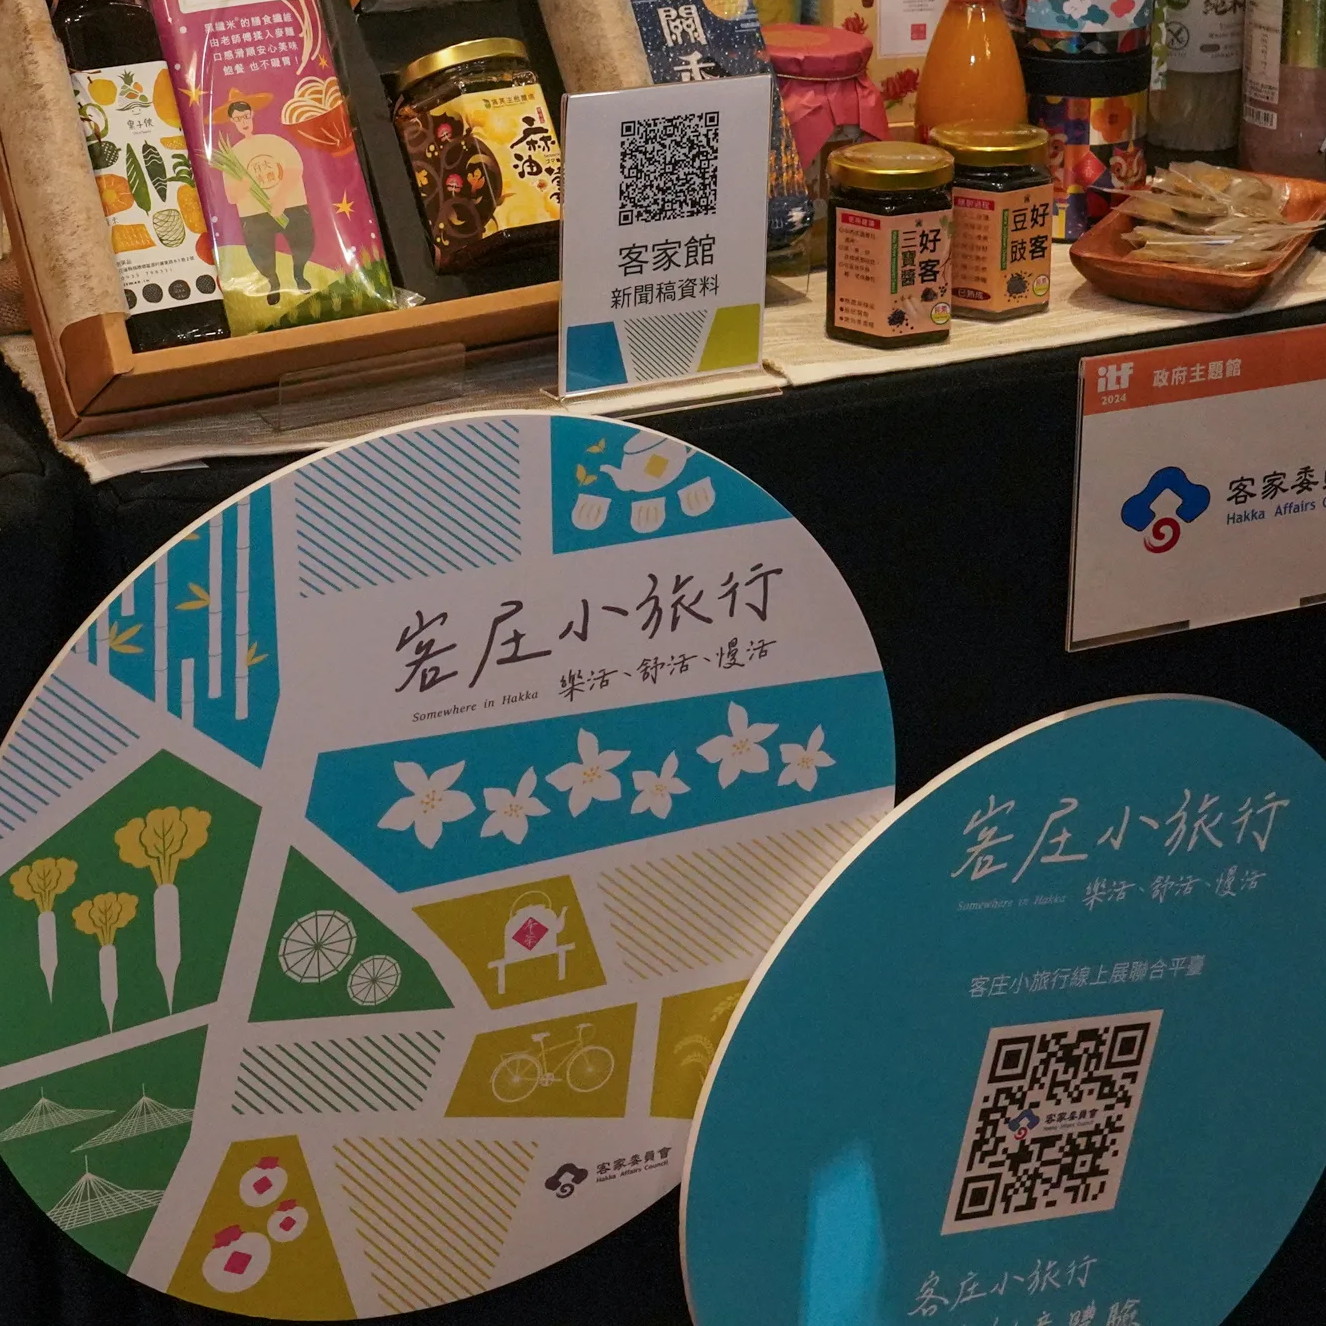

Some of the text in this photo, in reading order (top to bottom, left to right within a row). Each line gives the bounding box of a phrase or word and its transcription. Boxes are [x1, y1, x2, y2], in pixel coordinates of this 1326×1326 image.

[617, 233, 717, 277] 客家館
[610, 275, 720, 310] 新聞稿資料
[1097, 361, 1134, 393] itf
[1152, 357, 1243, 388] 政府主題館
[1101, 393, 1128, 405] 2024
[1226, 507, 1266, 526] Hakka
[1274, 499, 1317, 518] Affairs
[411, 688, 540, 725] Somewhere in Hakka
[956, 896, 1014, 912] Somewhere
[1033, 893, 1066, 906] Hakka
[968, 953, 1206, 1000] 客庄小旅行線上展聯合平臺
[596, 1146, 672, 1175] 客家委員會
[596, 1159, 669, 1183] Hakka Affairs Council
[907, 1254, 1098, 1317] 客庄小旅行
